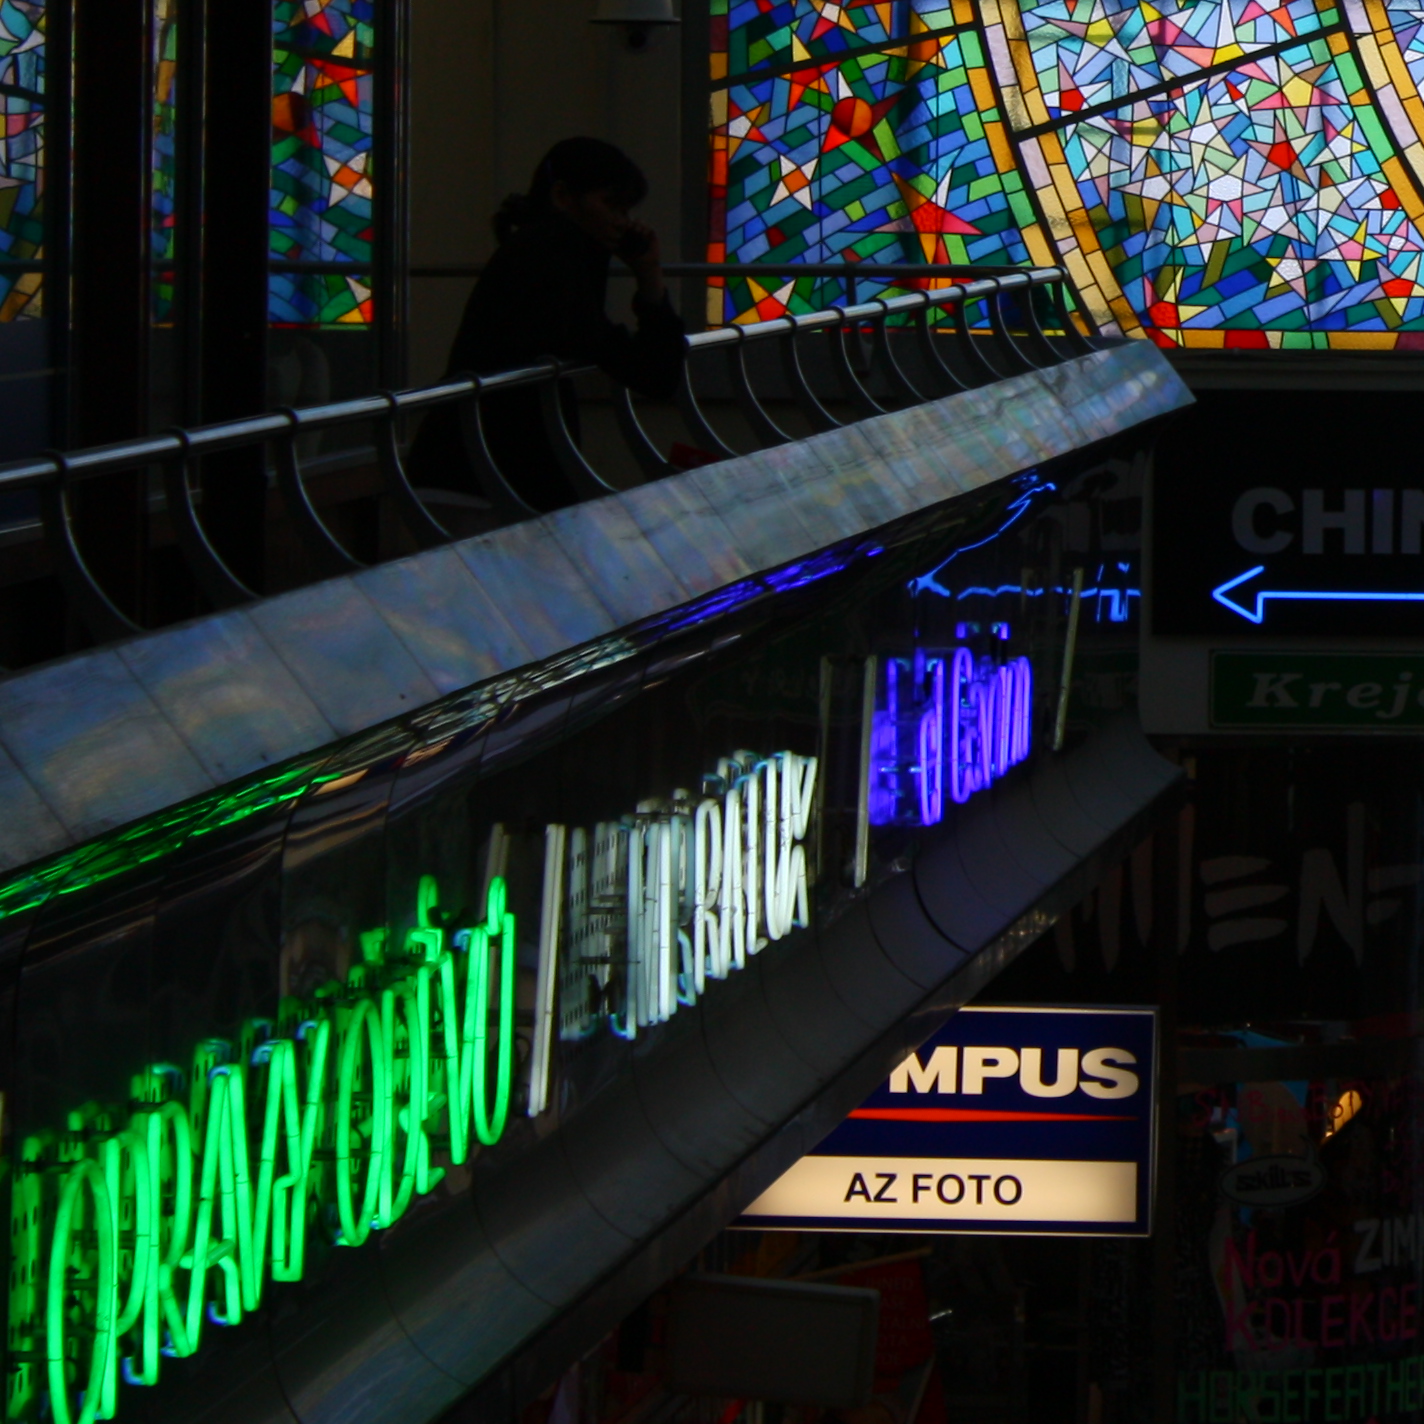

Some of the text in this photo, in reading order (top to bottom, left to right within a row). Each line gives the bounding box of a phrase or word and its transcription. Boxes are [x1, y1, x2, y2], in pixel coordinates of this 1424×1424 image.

[885, 1045, 1141, 1101] MPUS
[844, 1172, 1024, 1206] AZ FOTO
[1223, 1229, 1343, 1290] Nová
[1222, 1282, 1420, 1353] KOLEKCE
